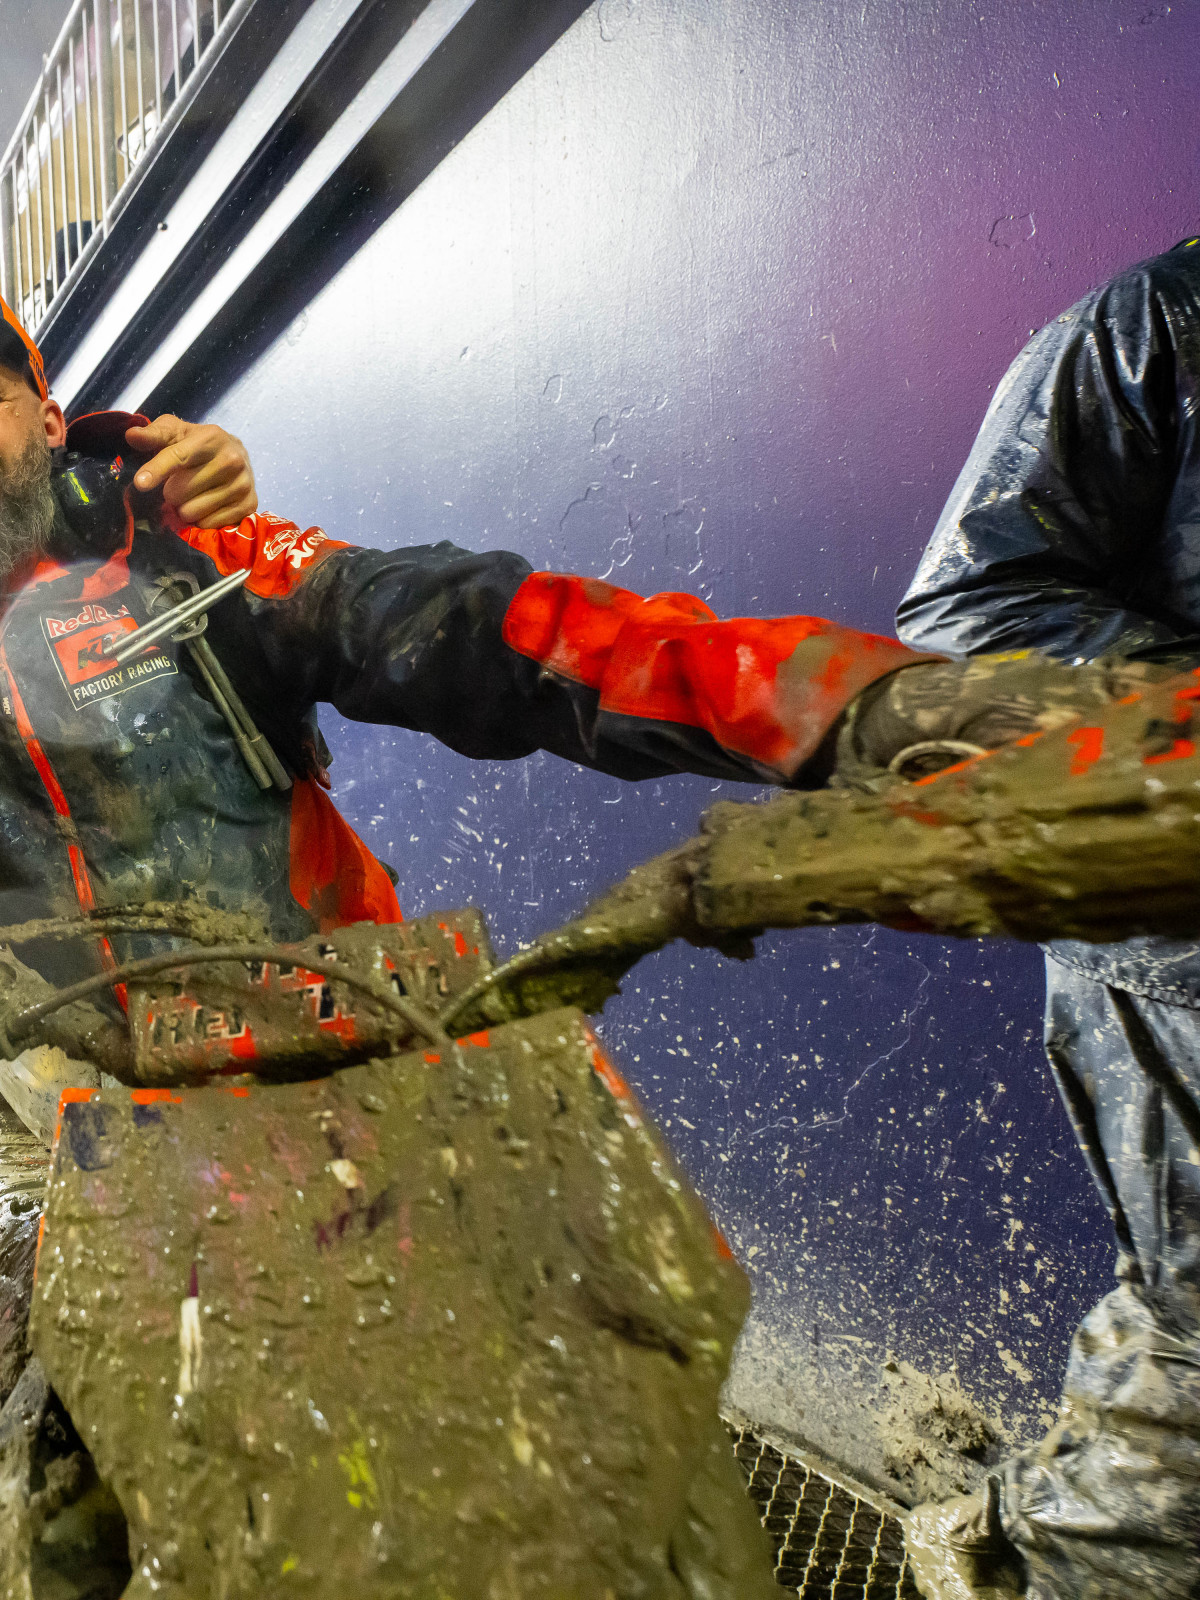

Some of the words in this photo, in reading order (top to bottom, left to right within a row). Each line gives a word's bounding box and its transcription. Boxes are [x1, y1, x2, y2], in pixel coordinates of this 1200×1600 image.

[46, 604, 95, 638] Red
[73, 671, 123, 701] FACTORY
[127, 655, 171, 680] RACING
